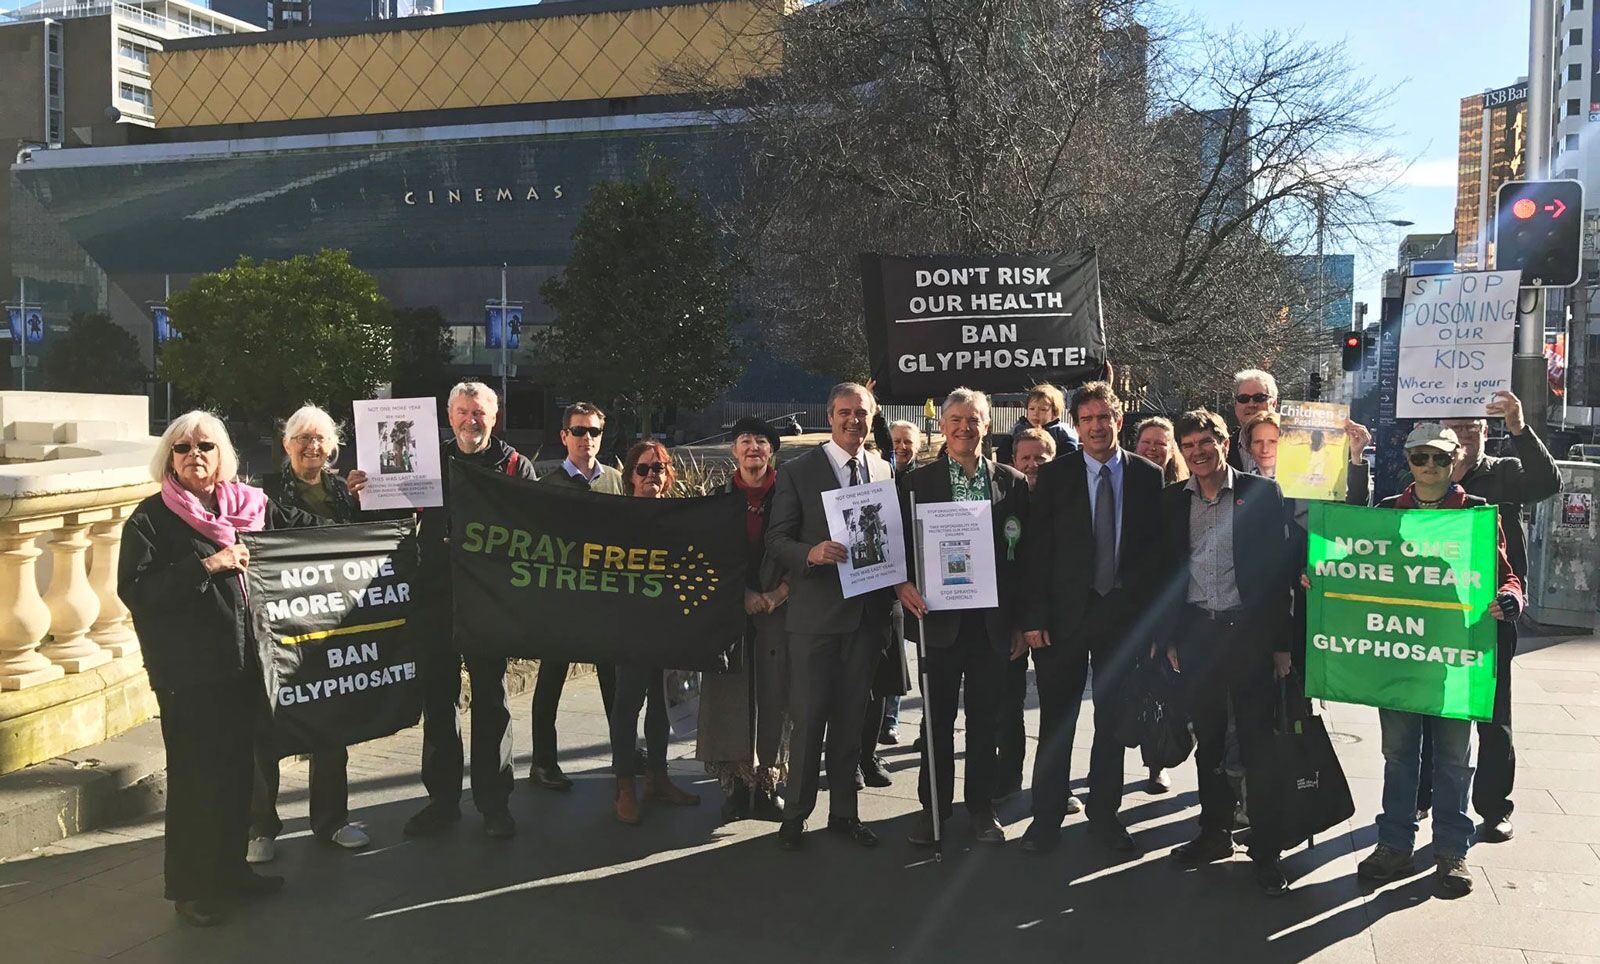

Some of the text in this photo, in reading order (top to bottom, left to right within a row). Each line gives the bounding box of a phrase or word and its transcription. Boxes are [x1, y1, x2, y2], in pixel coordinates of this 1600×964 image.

[1485, 87, 1528, 107] TSB Ban
[404, 185, 562, 205] CINEMAS
[916, 267, 1051, 288] DON'T RISK
[1412, 275, 1503, 296] STOP
[909, 292, 1063, 314] OUR HEALTH
[1402, 299, 1516, 327] POISONING
[962, 324, 1018, 344] BAN
[1439, 327, 1483, 340] OUR
[898, 347, 1086, 373] GLYPHOSATE!
[1434, 349, 1486, 371] KIDS
[1399, 377, 1445, 389] Where
[1456, 378, 1468, 389] is
[1474, 379, 1506, 393] your
[1280, 405, 1334, 419] Children
[462, 522, 668, 570] SPRAY FREE
[1335, 536, 1461, 559] NOT ONE
[280, 557, 395, 589] NOT ONE
[510, 561, 666, 598] STREETS
[1315, 560, 1482, 588] MORE YEAR
[266, 582, 411, 622] MORE YEAR
[1367, 613, 1425, 637] BAN
[327, 642, 379, 669] BAN
[1312, 634, 1484, 667] GLYPHOSATE!
[278, 661, 416, 706] GLYPHOSATE!
